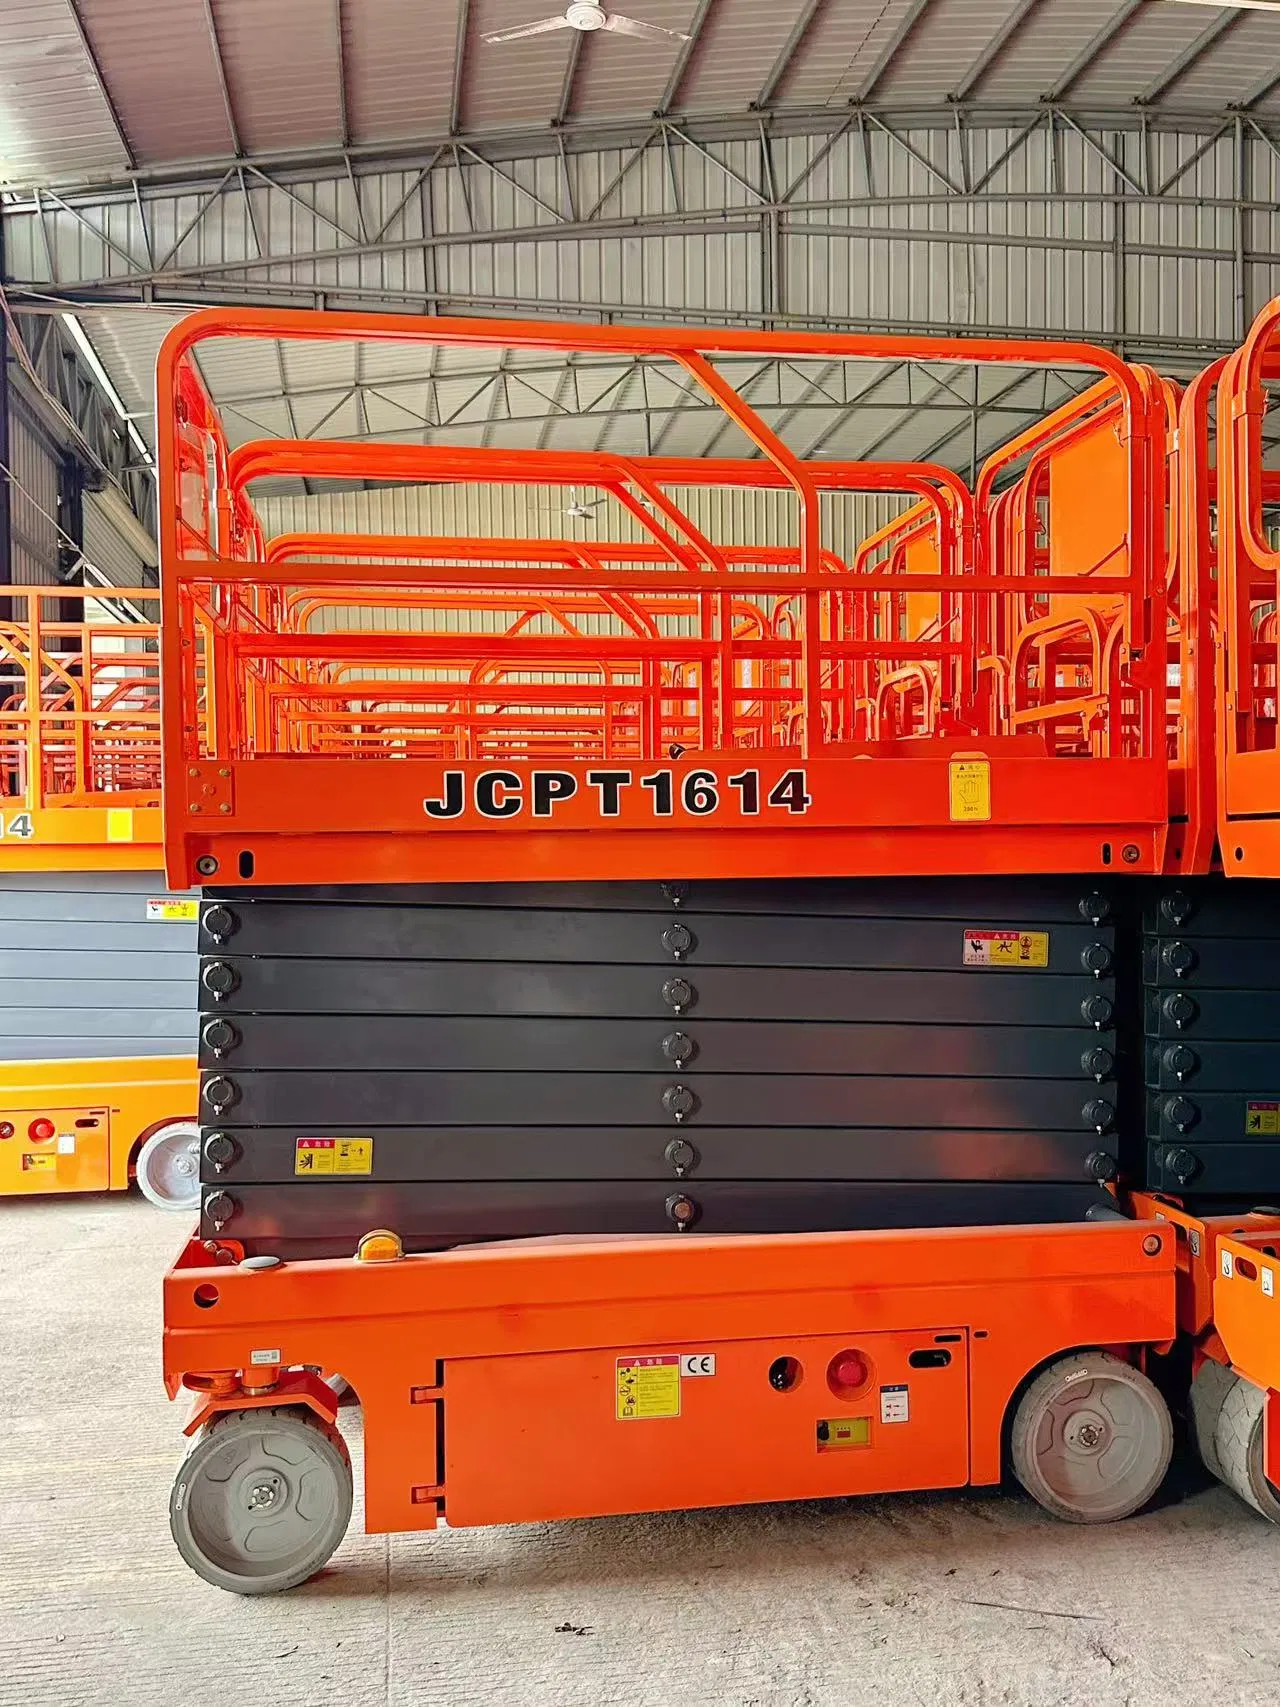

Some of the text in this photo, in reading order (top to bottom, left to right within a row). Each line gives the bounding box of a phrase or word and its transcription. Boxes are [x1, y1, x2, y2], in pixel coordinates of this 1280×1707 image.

[423, 769, 811, 819] JCPT1614
[0, 813, 34, 839] 4
[687, 1356, 710, 1373] CE
